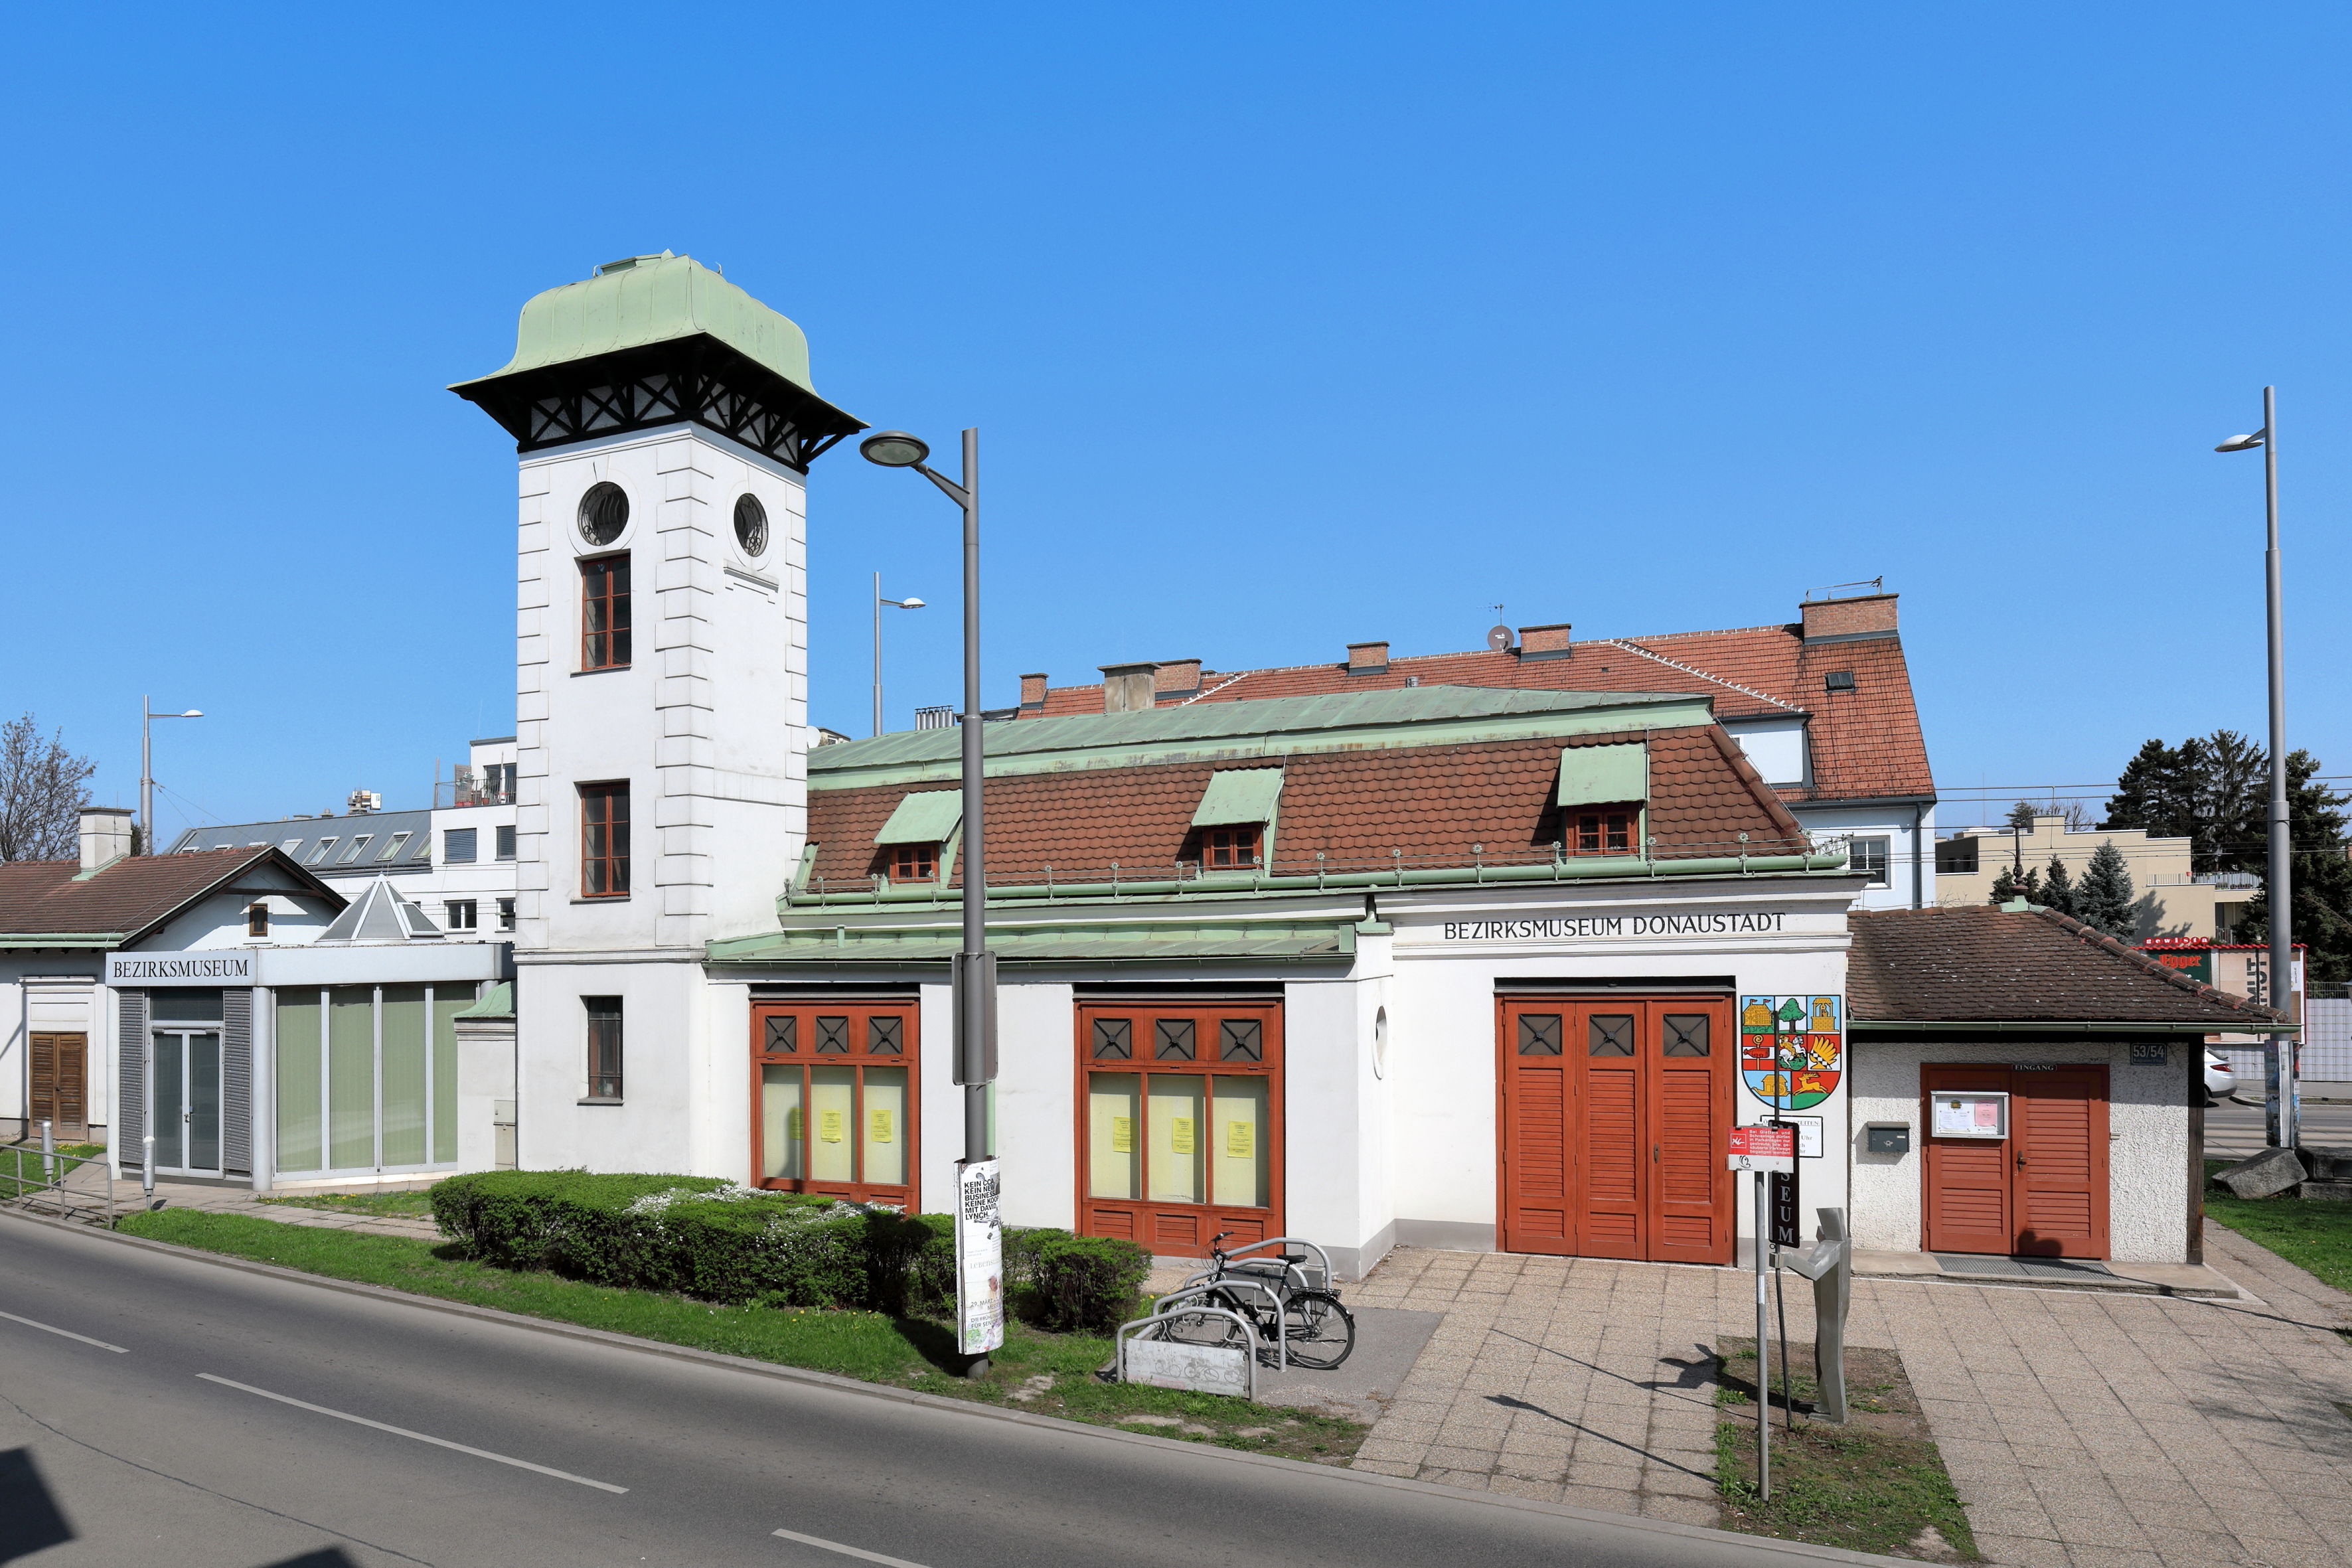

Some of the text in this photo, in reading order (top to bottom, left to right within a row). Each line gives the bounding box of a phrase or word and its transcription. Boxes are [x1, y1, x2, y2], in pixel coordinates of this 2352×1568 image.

[1445, 912, 1786, 939] BEZIRKSMUSEUM DONAUSTADT
[114, 959, 249, 978] BEZIRKSMUSEUM
[2159, 953, 2202, 969] Egger
[2133, 1045, 2165, 1058] 53/54
[965, 1199, 986, 1208] KEINE
